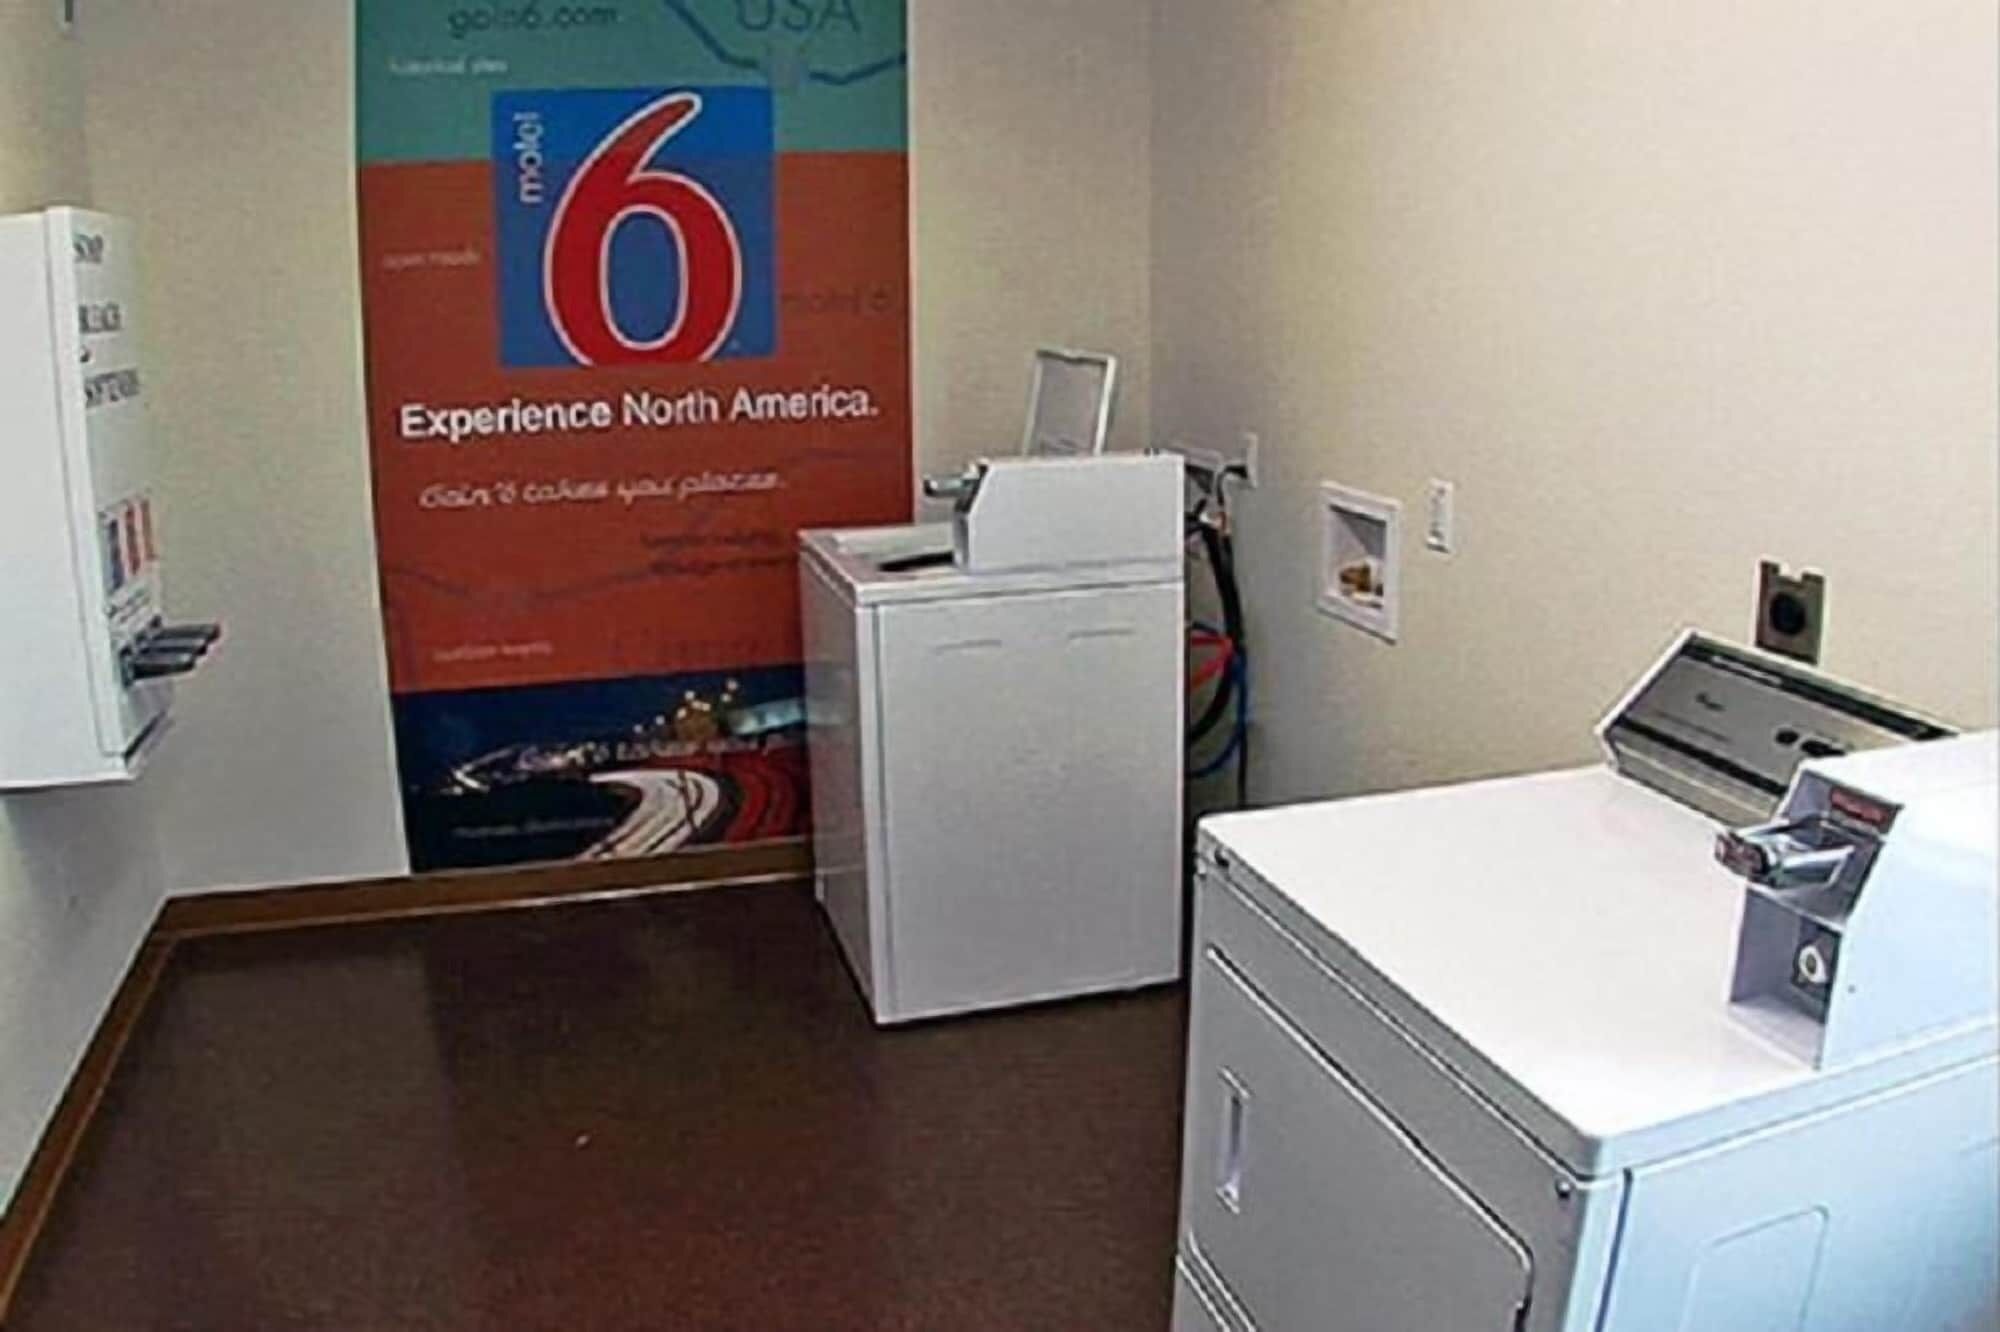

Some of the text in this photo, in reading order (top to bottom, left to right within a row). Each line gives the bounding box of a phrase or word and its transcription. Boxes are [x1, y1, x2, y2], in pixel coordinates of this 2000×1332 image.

[736, 0, 861, 32] USA
[513, 112, 543, 203] motel
[543, 92, 742, 367] 6
[401, 381, 879, 443] Experience North America.
